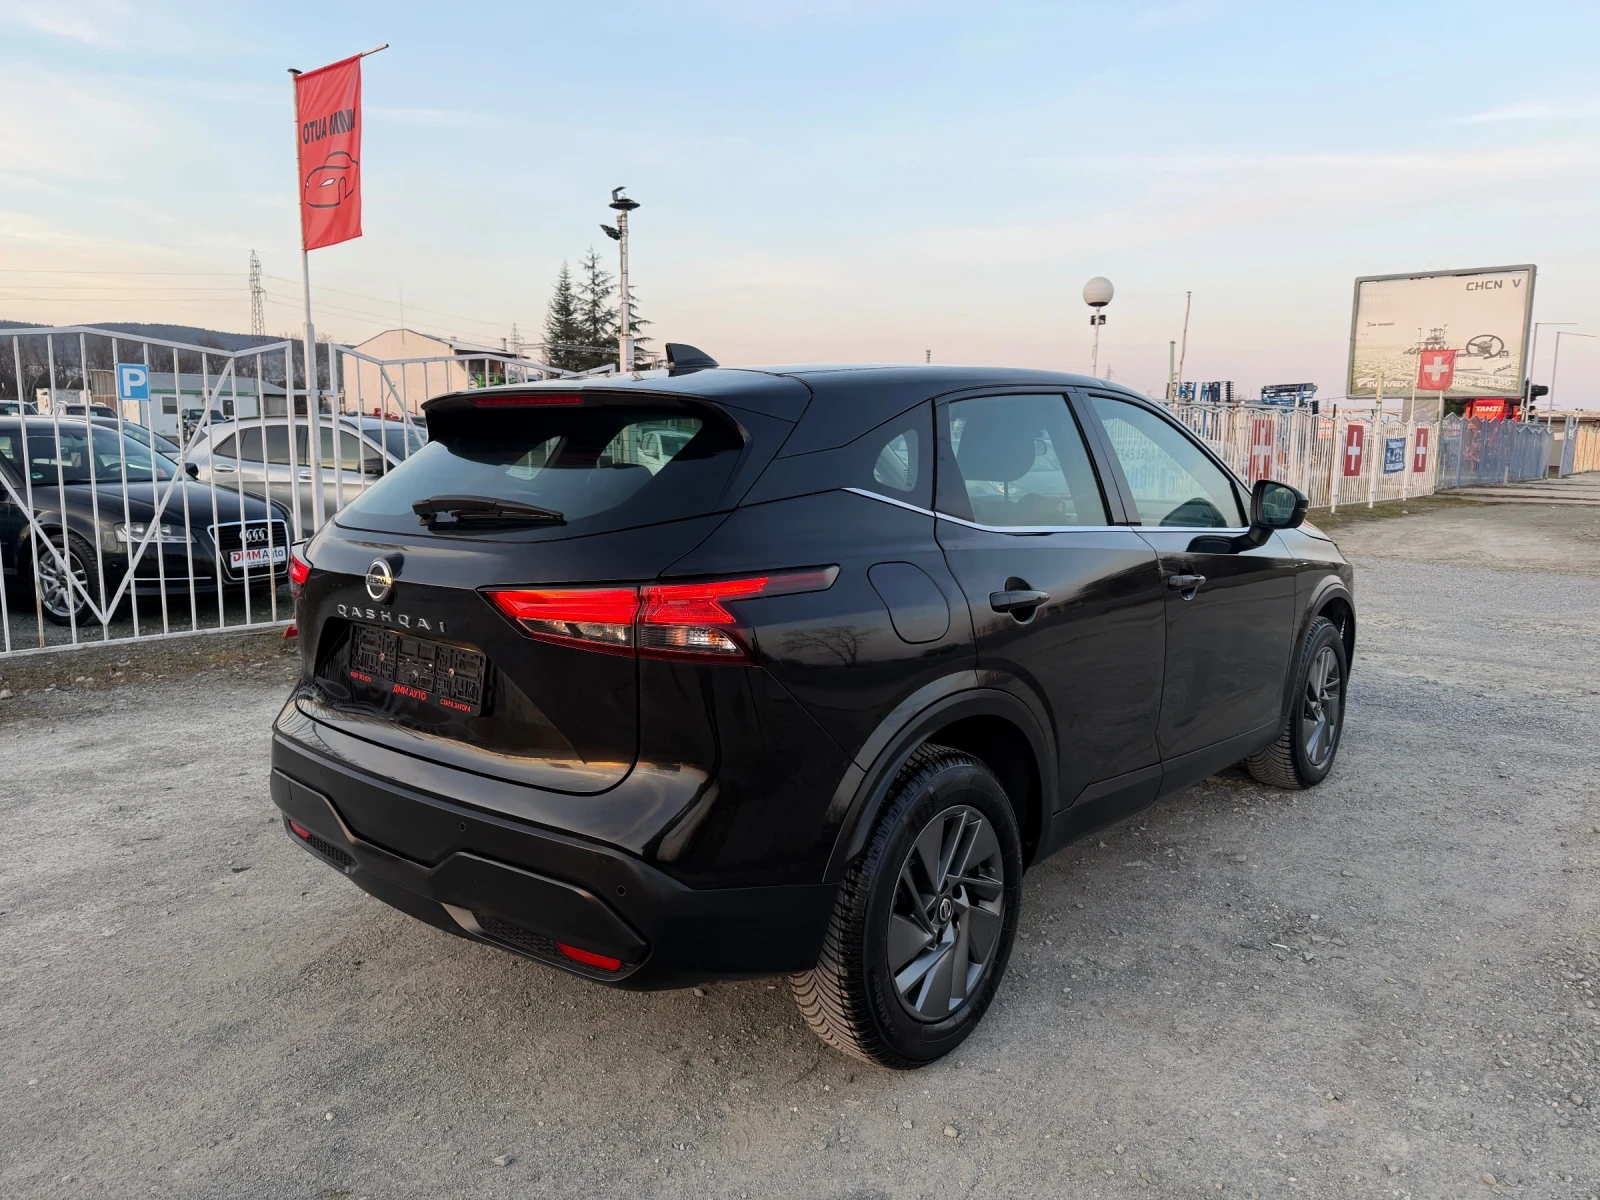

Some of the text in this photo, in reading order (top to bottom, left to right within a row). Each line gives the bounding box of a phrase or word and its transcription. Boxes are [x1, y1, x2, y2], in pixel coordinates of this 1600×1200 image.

[122, 367, 147, 397] P
[337, 604, 446, 633] QASHQAI
[409, 689, 427, 701] АУТО
